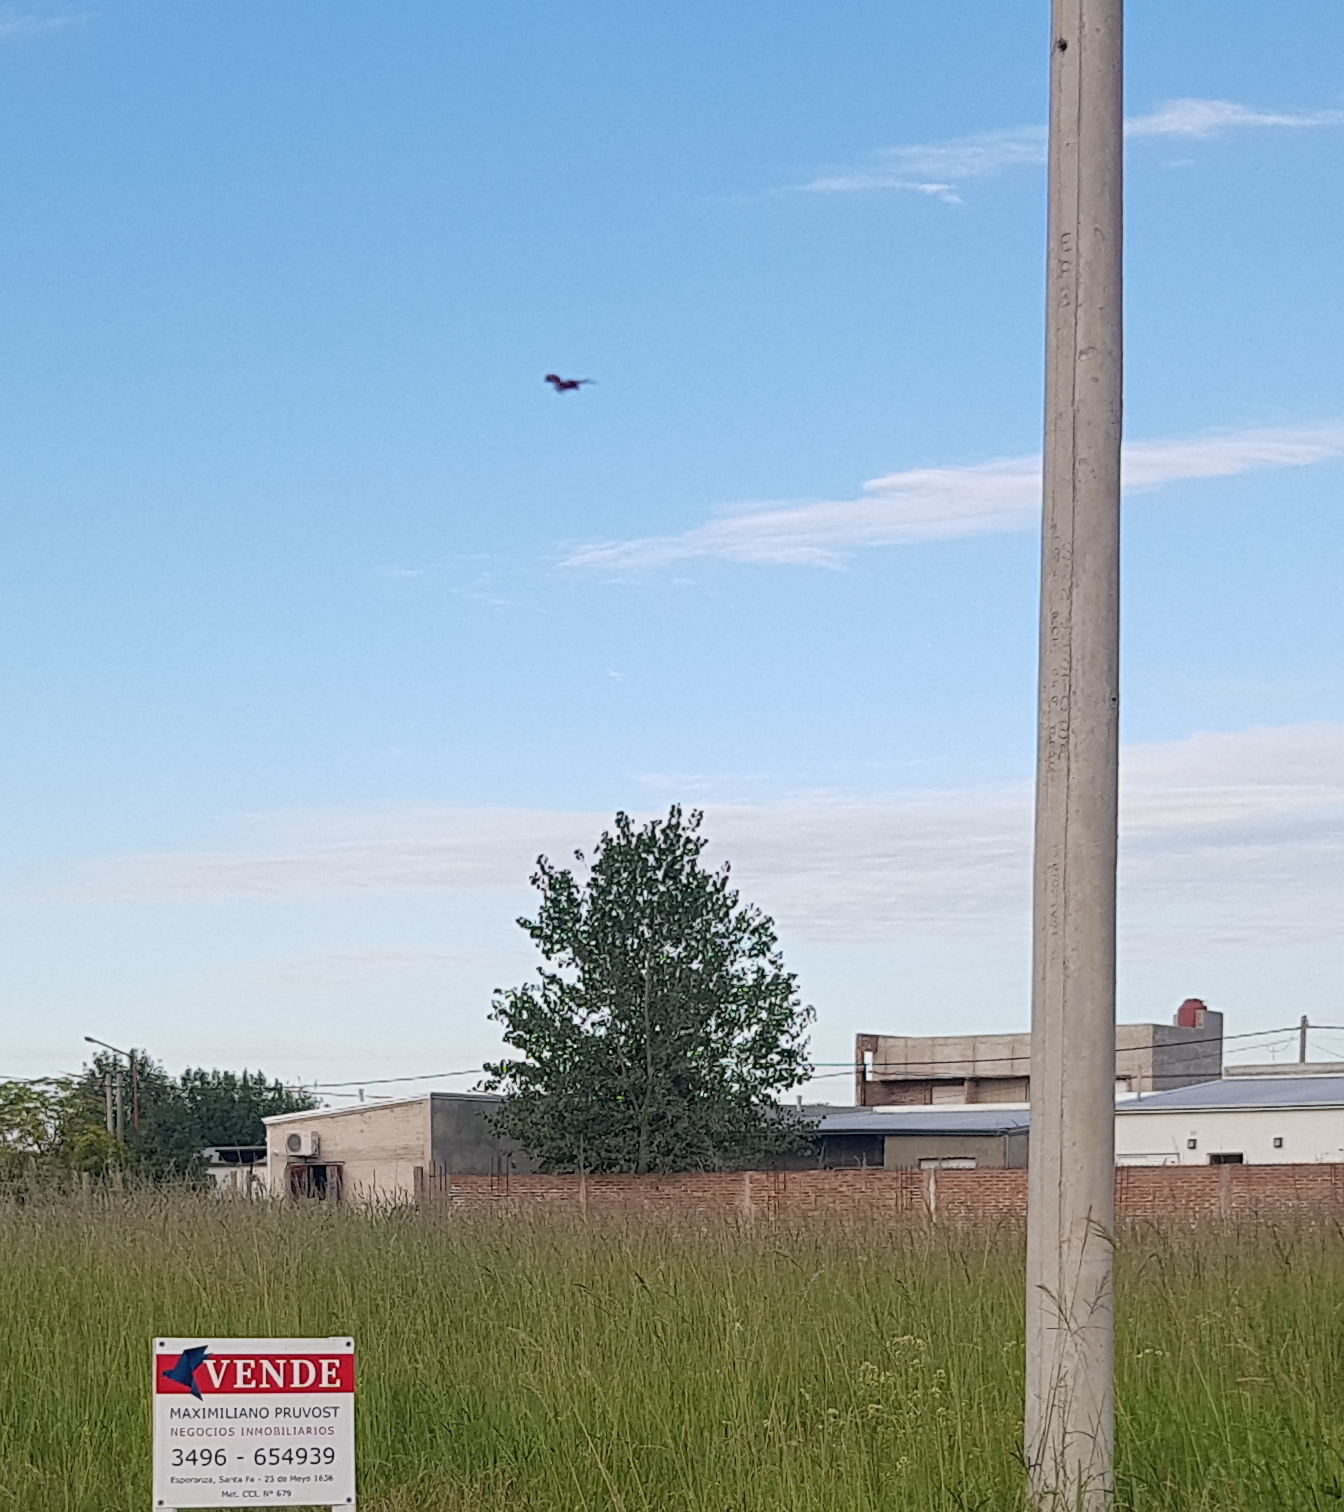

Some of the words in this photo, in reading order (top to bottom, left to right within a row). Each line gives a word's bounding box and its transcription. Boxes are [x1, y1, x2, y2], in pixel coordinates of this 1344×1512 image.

[203, 1359, 341, 1389] VENDE
[169, 1407, 270, 1420] MAXIMILIANO
[274, 1406, 340, 1419] PRUVOST
[170, 1427, 236, 1437] NEGOCIOS
[241, 1426, 335, 1436] INMOBILIARIOS
[171, 1448, 227, 1467] 3496
[254, 1447, 335, 1466] 654939
